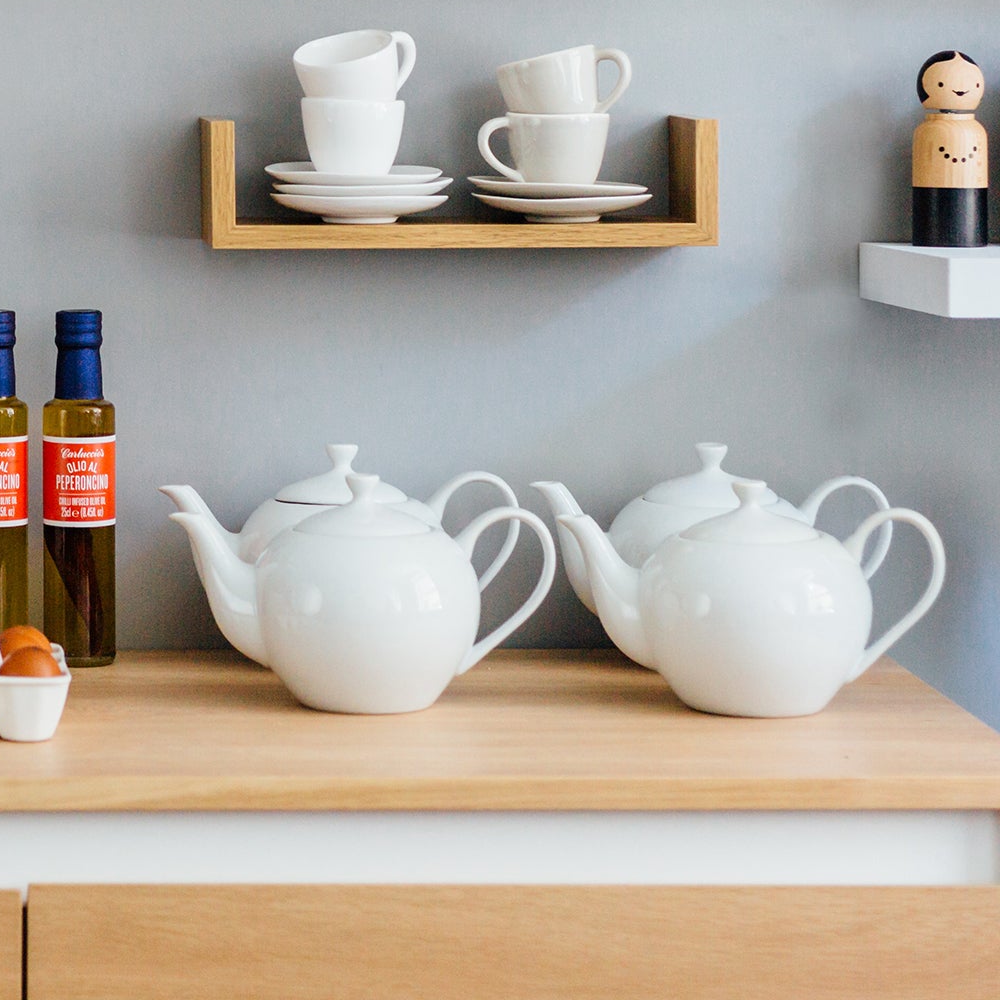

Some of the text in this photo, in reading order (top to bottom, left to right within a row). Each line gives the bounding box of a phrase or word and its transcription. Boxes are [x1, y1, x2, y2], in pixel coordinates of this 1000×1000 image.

[61, 447, 105, 459] Carluccio's
[66, 460, 98, 474] OLIO AL
[56, 474, 109, 490] PEPERONCINO
